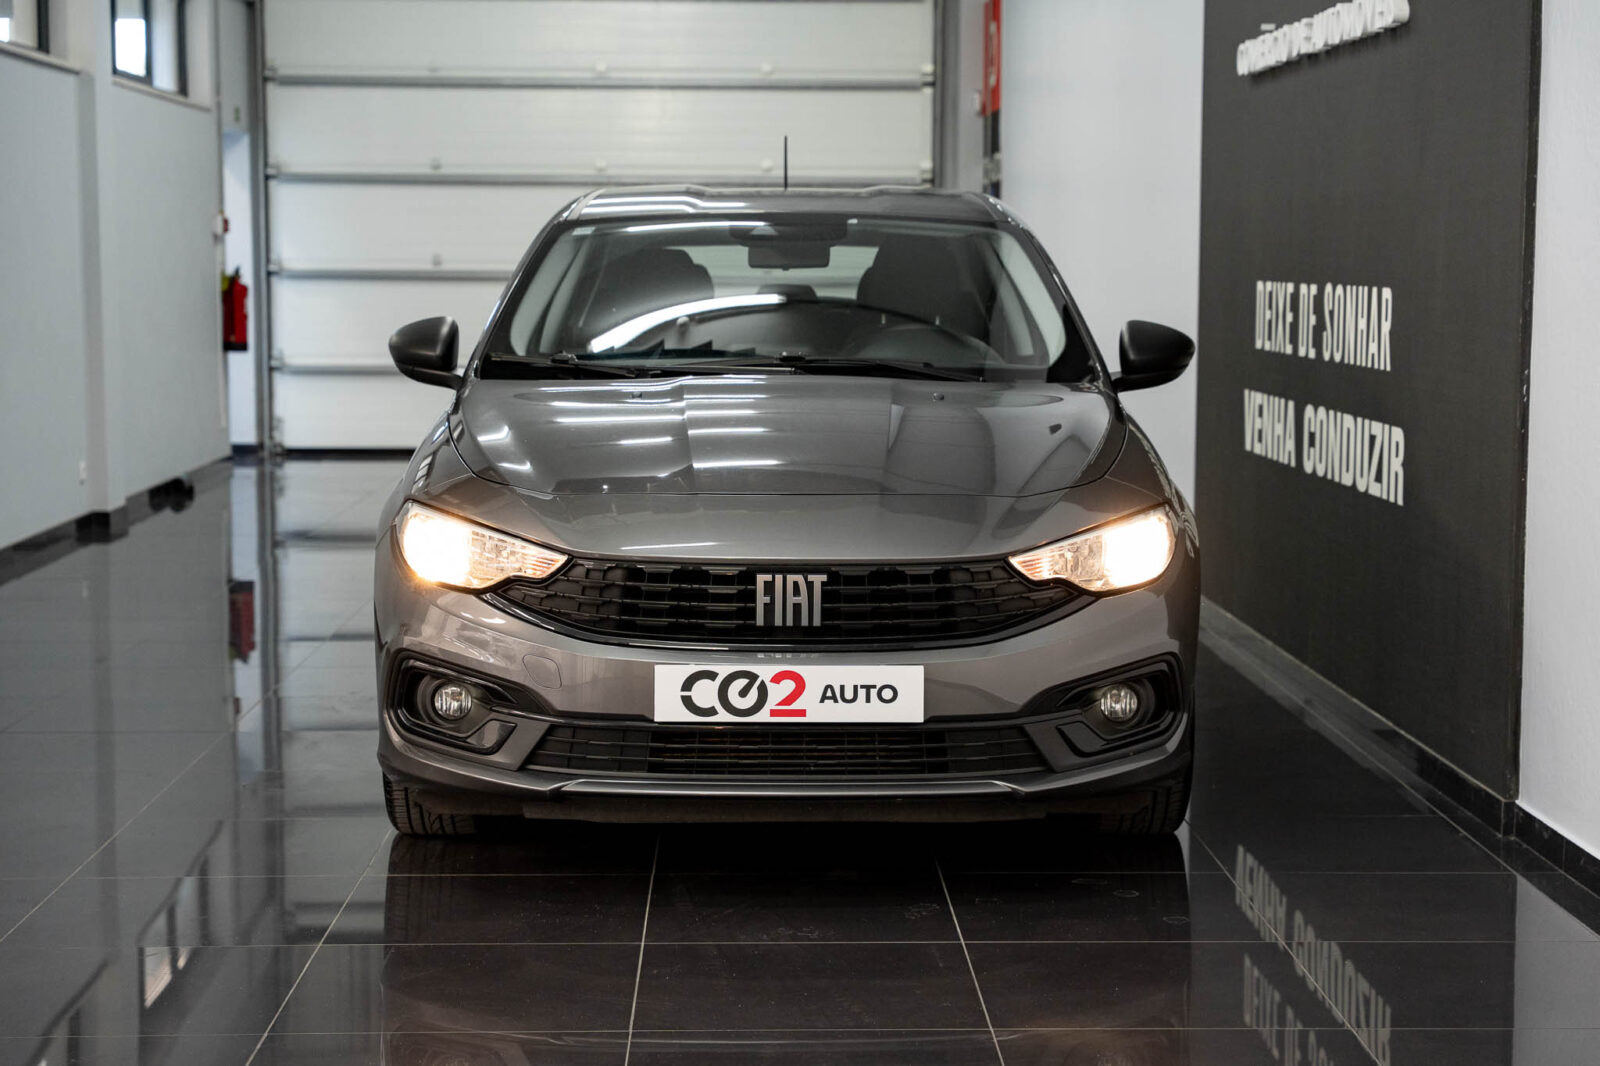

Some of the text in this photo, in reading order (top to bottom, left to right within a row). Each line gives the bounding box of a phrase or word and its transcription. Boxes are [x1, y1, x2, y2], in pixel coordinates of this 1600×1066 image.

[1254, 280, 1393, 372] DEIXE DE SONHAR
[1243, 388, 1406, 506] VENHA CONDUZIR
[755, 573, 828, 627] FIAT
[680, 669, 899, 718] CO2 AUTO
